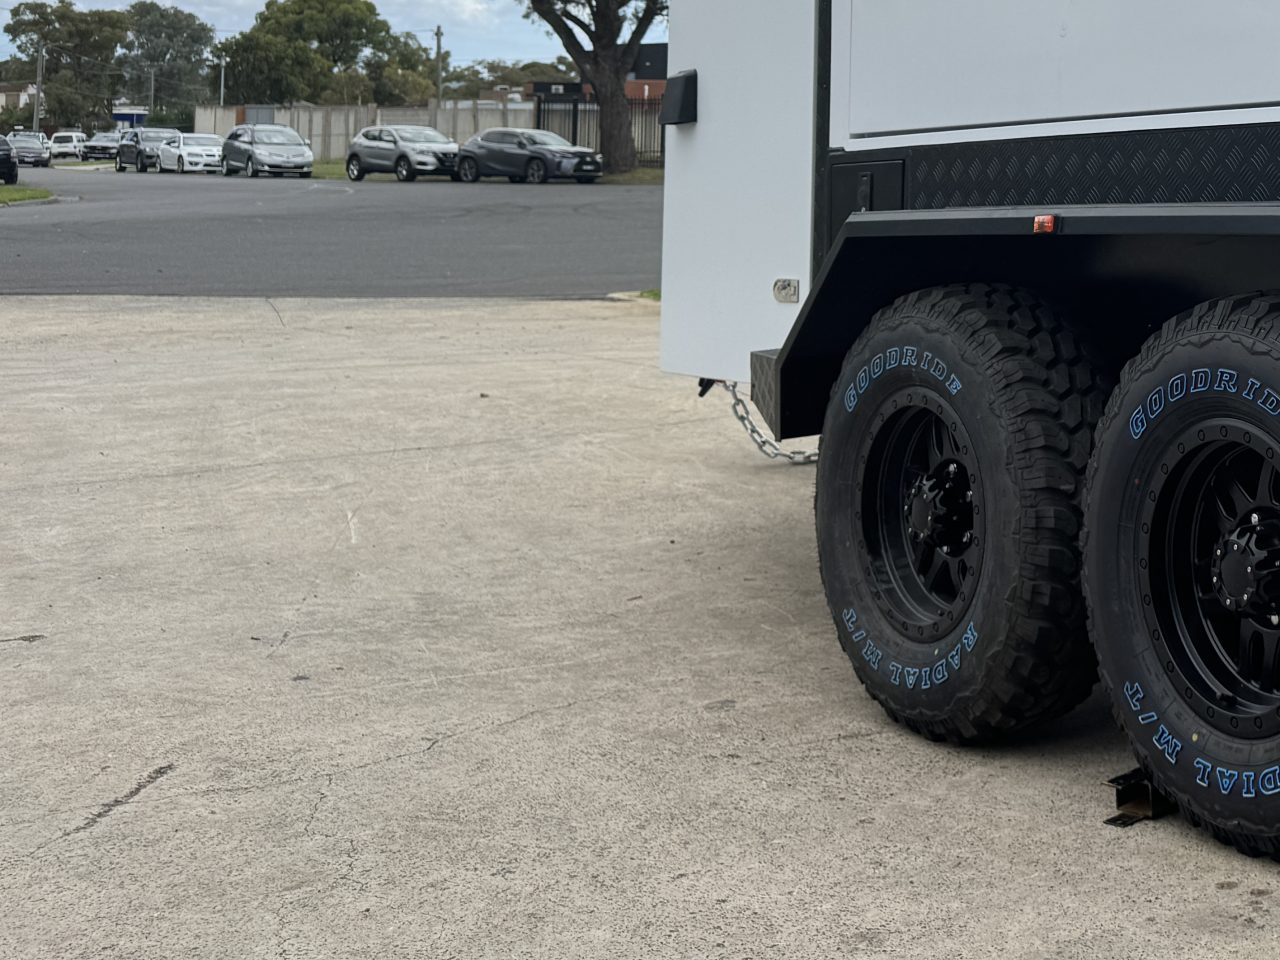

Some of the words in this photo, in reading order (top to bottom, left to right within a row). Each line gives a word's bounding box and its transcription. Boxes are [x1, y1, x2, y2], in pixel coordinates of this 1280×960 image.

[845, 346, 962, 412] GOODRIDE
[843, 608, 882, 670] M/T
[890, 622, 978, 689] RADIAL
[1124, 681, 1182, 764] M/T
